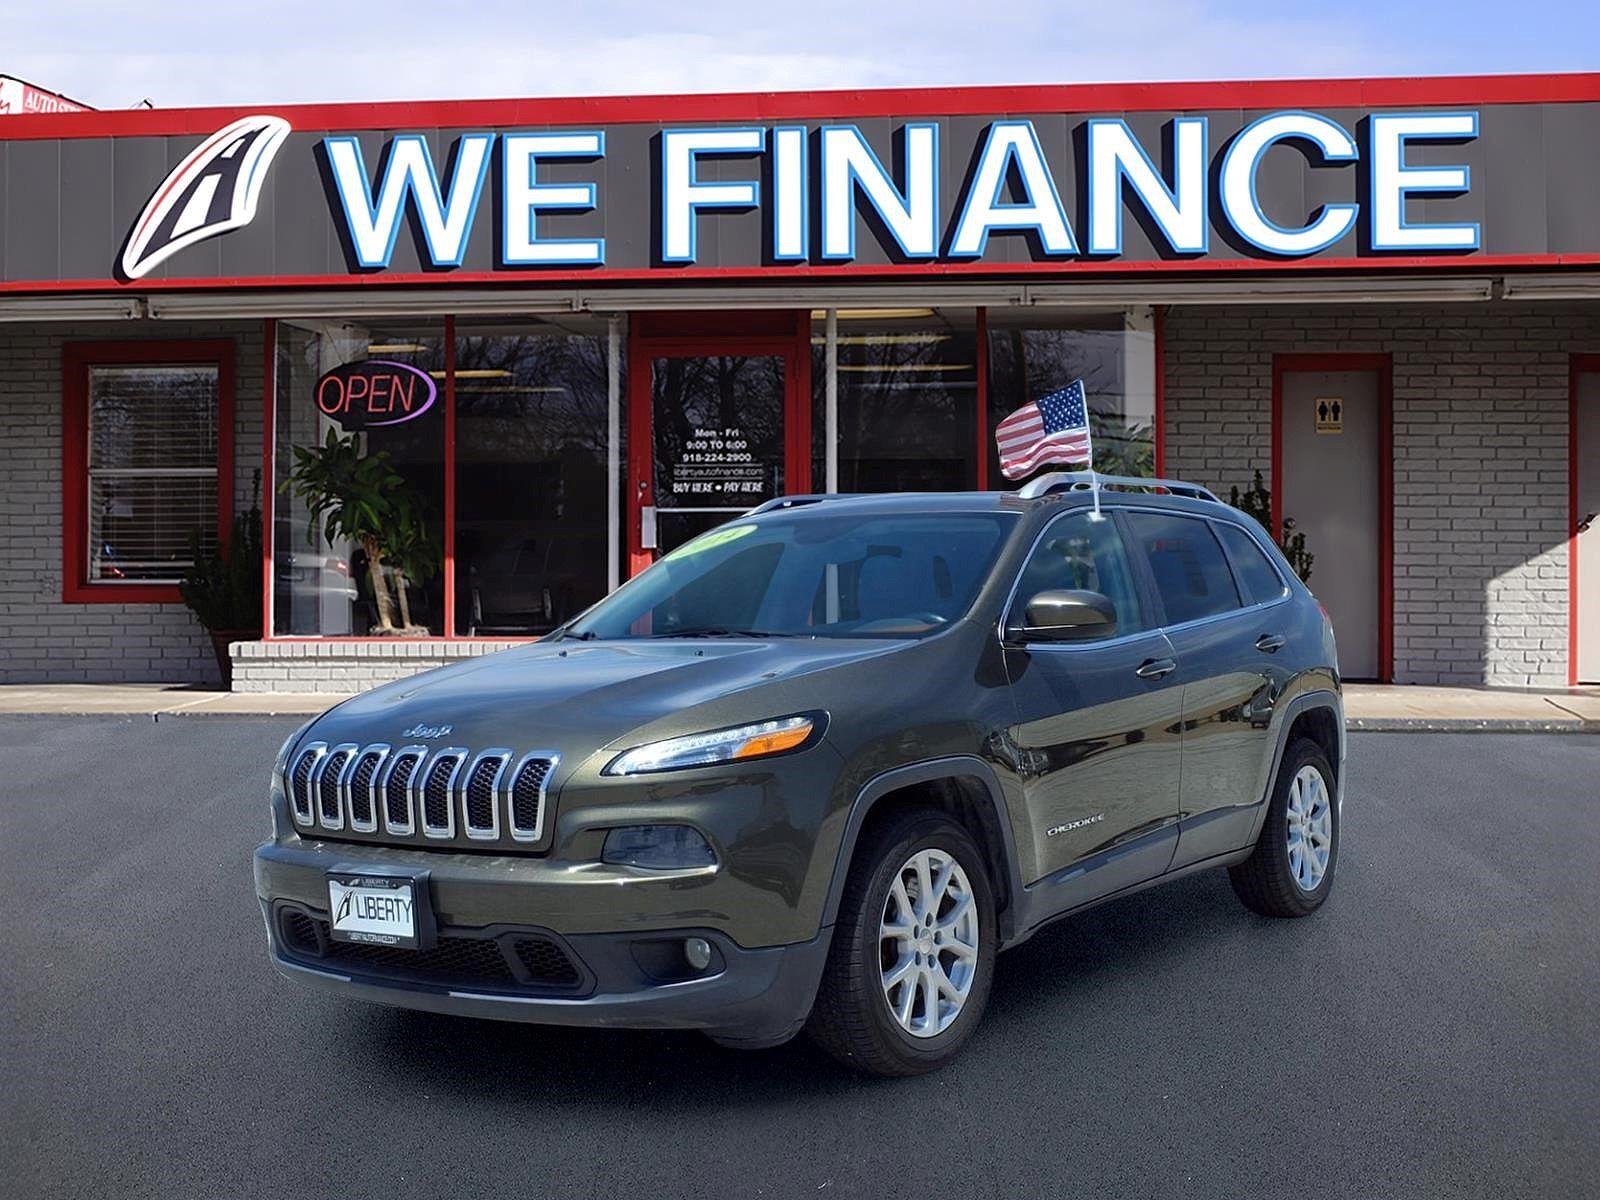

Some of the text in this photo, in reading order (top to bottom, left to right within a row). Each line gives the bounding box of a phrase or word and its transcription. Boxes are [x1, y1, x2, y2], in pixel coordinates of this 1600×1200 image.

[25, 91, 57, 113] AUTO
[323, 110, 1480, 268] WE FINANCE
[319, 375, 415, 414] OPEN
[695, 429, 716, 437] Mon
[726, 428, 740, 437] Fri
[686, 441, 747, 450] 9:00 TO 6:00
[682, 453, 752, 462] 918-224-2900
[672, 482, 764, 493] BUY HERE PAY HERE
[403, 723, 453, 739] Jeep
[1047, 813, 1105, 836] CHEROKEE
[355, 896, 413, 922] LIBERTY
